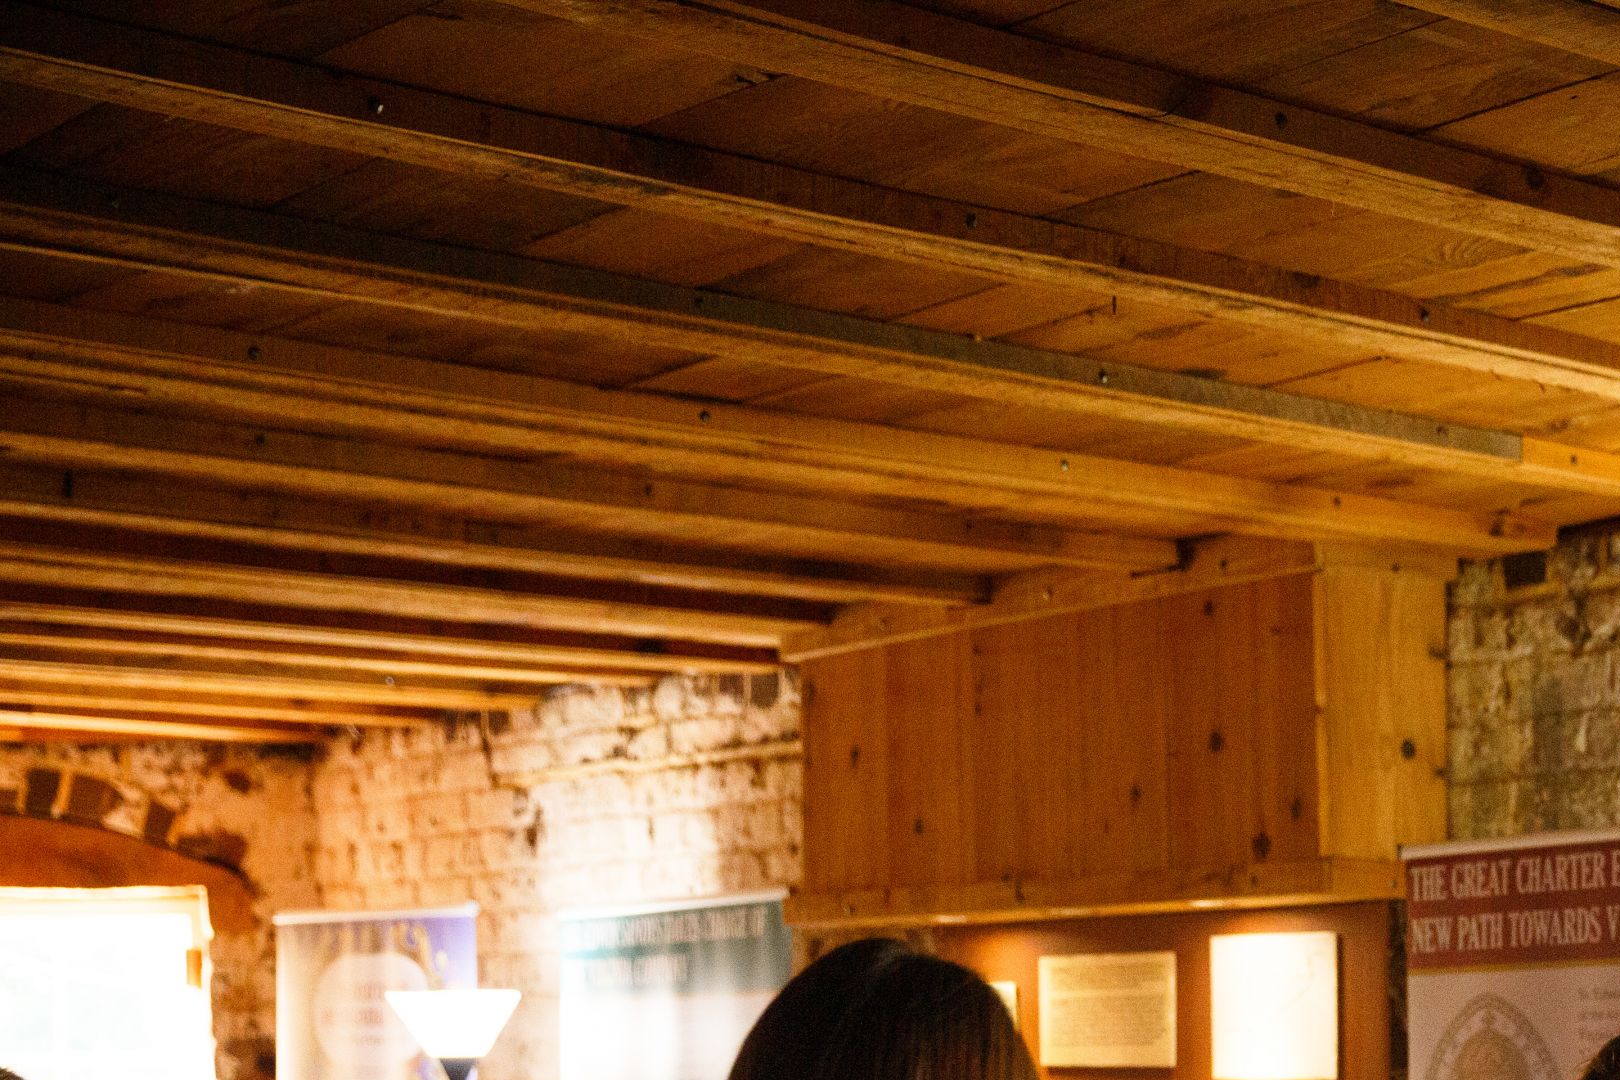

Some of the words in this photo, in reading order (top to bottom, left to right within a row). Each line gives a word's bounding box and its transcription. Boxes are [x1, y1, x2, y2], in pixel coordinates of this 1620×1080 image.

[1411, 866, 1446, 901] THE
[1451, 859, 1510, 898] GREAT
[1516, 853, 1605, 893] CHARTER
[1409, 917, 1452, 955] NEW
[1457, 913, 1503, 950] PATH
[1509, 907, 1601, 946] TOWARDS
